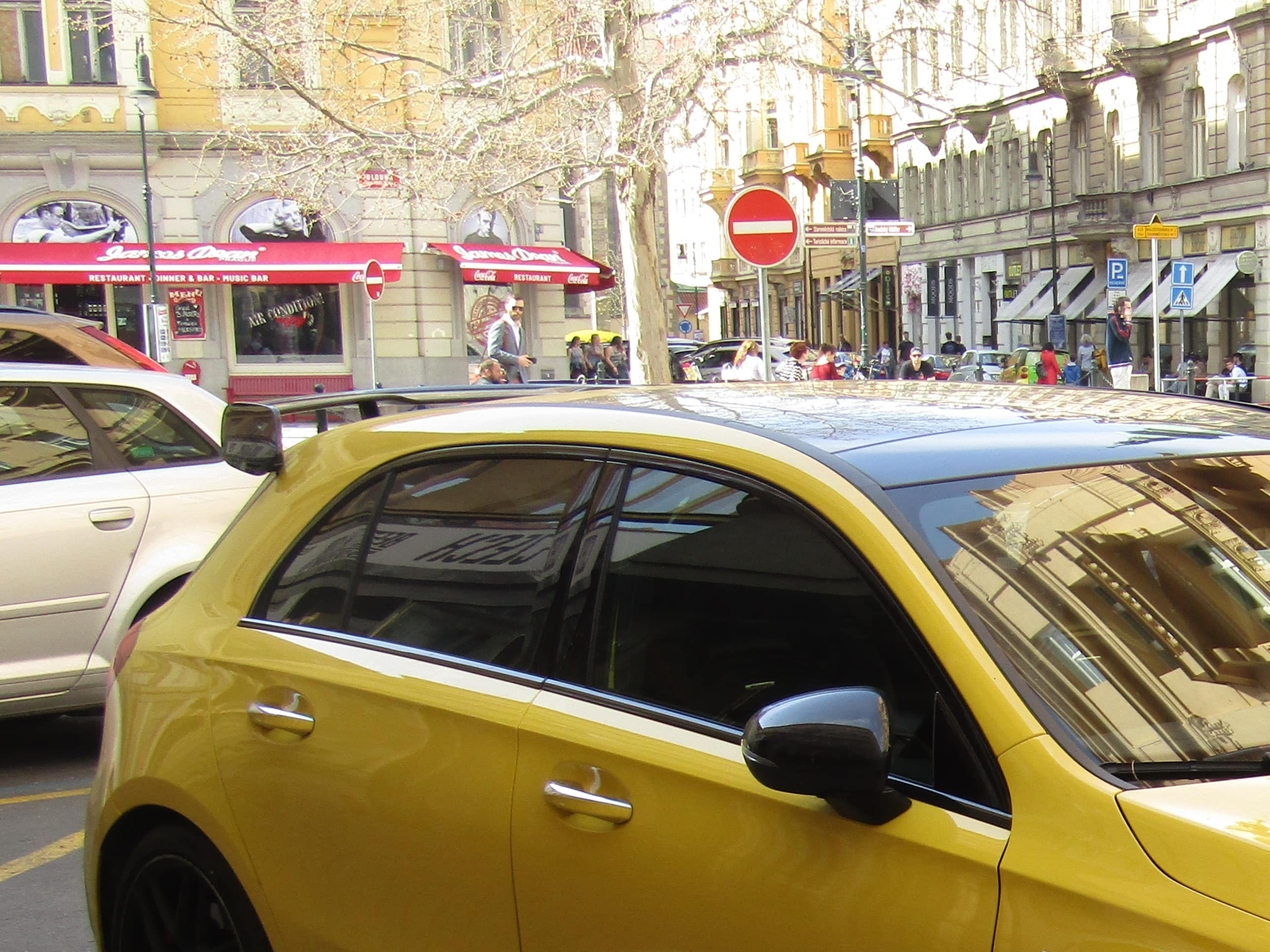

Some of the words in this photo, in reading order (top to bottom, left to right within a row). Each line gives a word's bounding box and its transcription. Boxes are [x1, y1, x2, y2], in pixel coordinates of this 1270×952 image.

[187, 245, 260, 260] Dean
[453, 245, 516, 261] James
[510, 248, 565, 263] Dean
[89, 274, 146, 283] RESTAURANT
[188, 274, 195, 283] &
[197, 274, 215, 283] BAR
[222, 274, 250, 283] MUSIC
[251, 274, 269, 283] BAR
[514, 273, 552, 283] RESTAURANT
[169, 288, 203, 298] MENU
[248, 312, 267, 328] AIR
